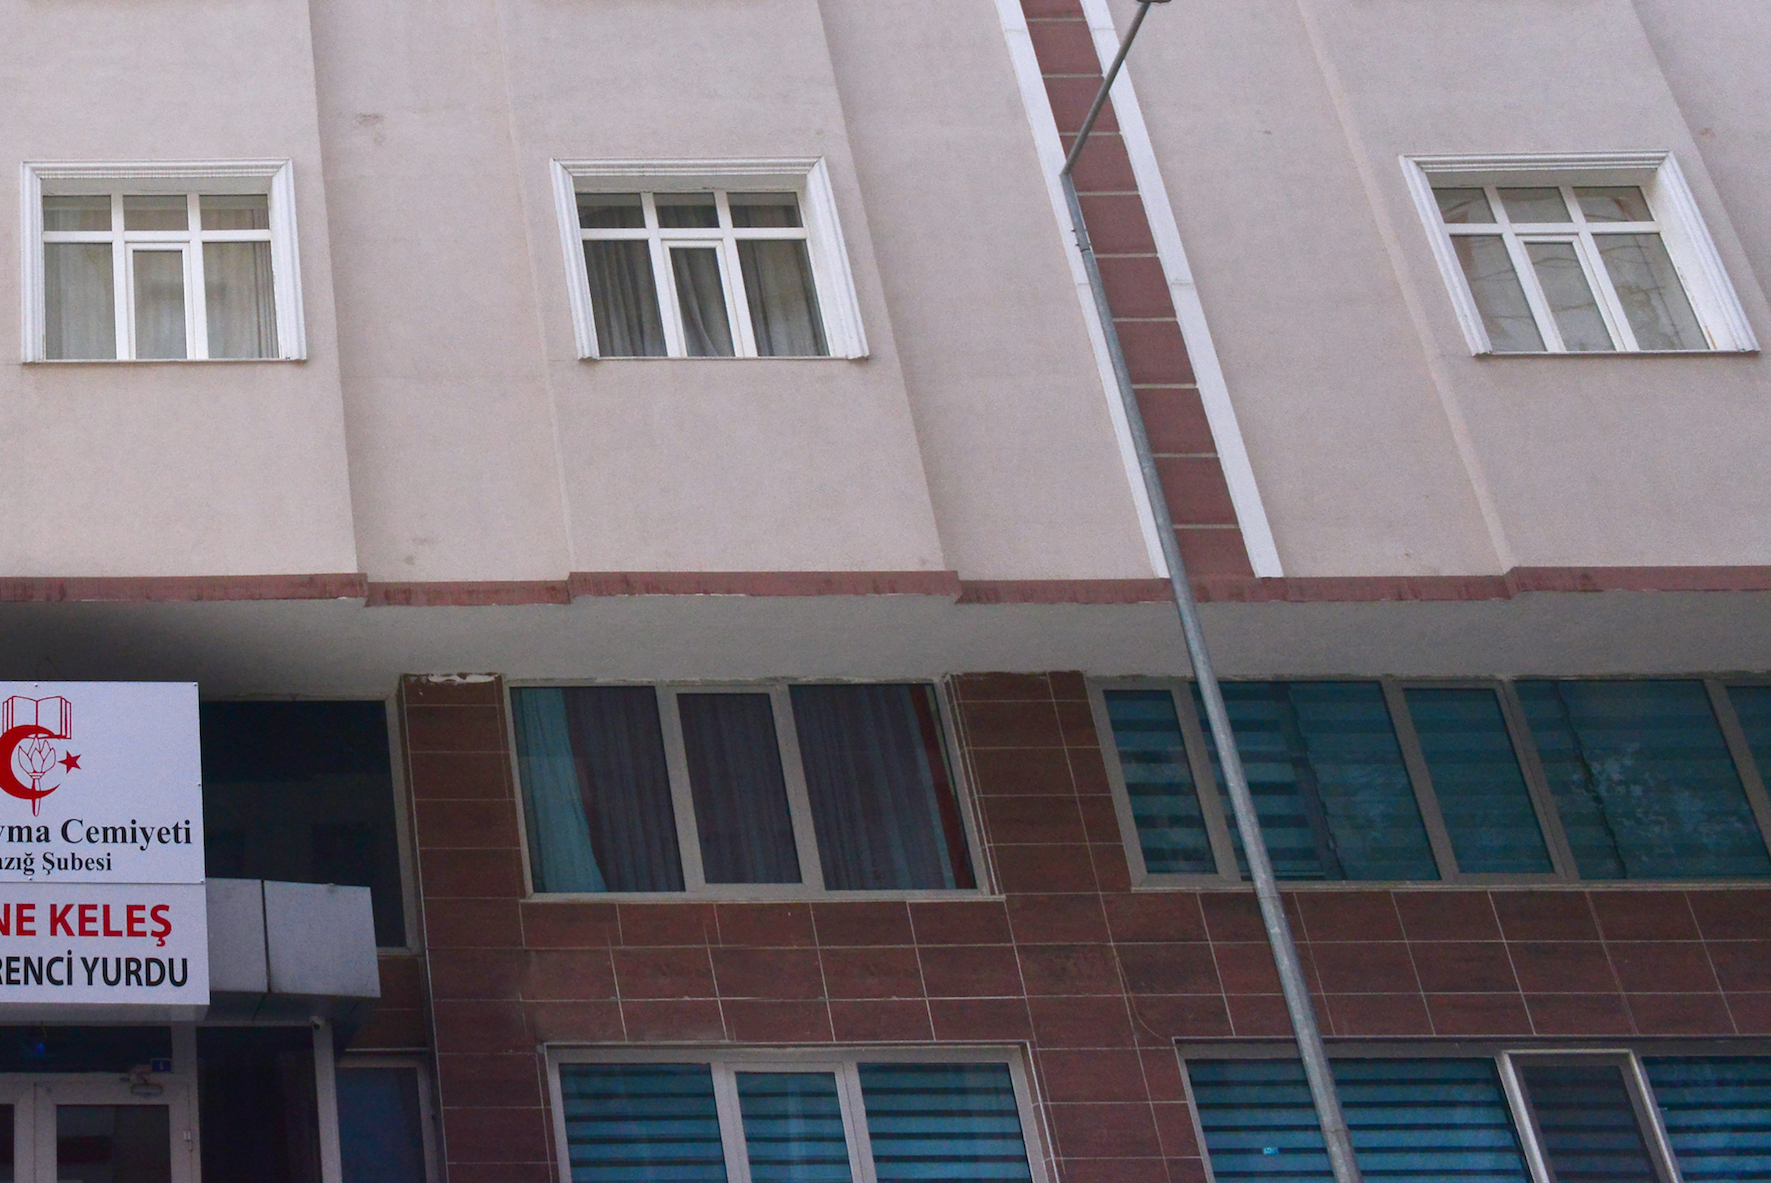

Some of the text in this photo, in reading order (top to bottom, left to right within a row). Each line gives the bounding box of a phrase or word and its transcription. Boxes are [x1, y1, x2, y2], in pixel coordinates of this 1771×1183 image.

[60, 818, 192, 851] Cemiyeti
[42, 852, 112, 876] Şubesi
[49, 903, 172, 947] KELEŞ
[80, 956, 189, 987] YURDU
